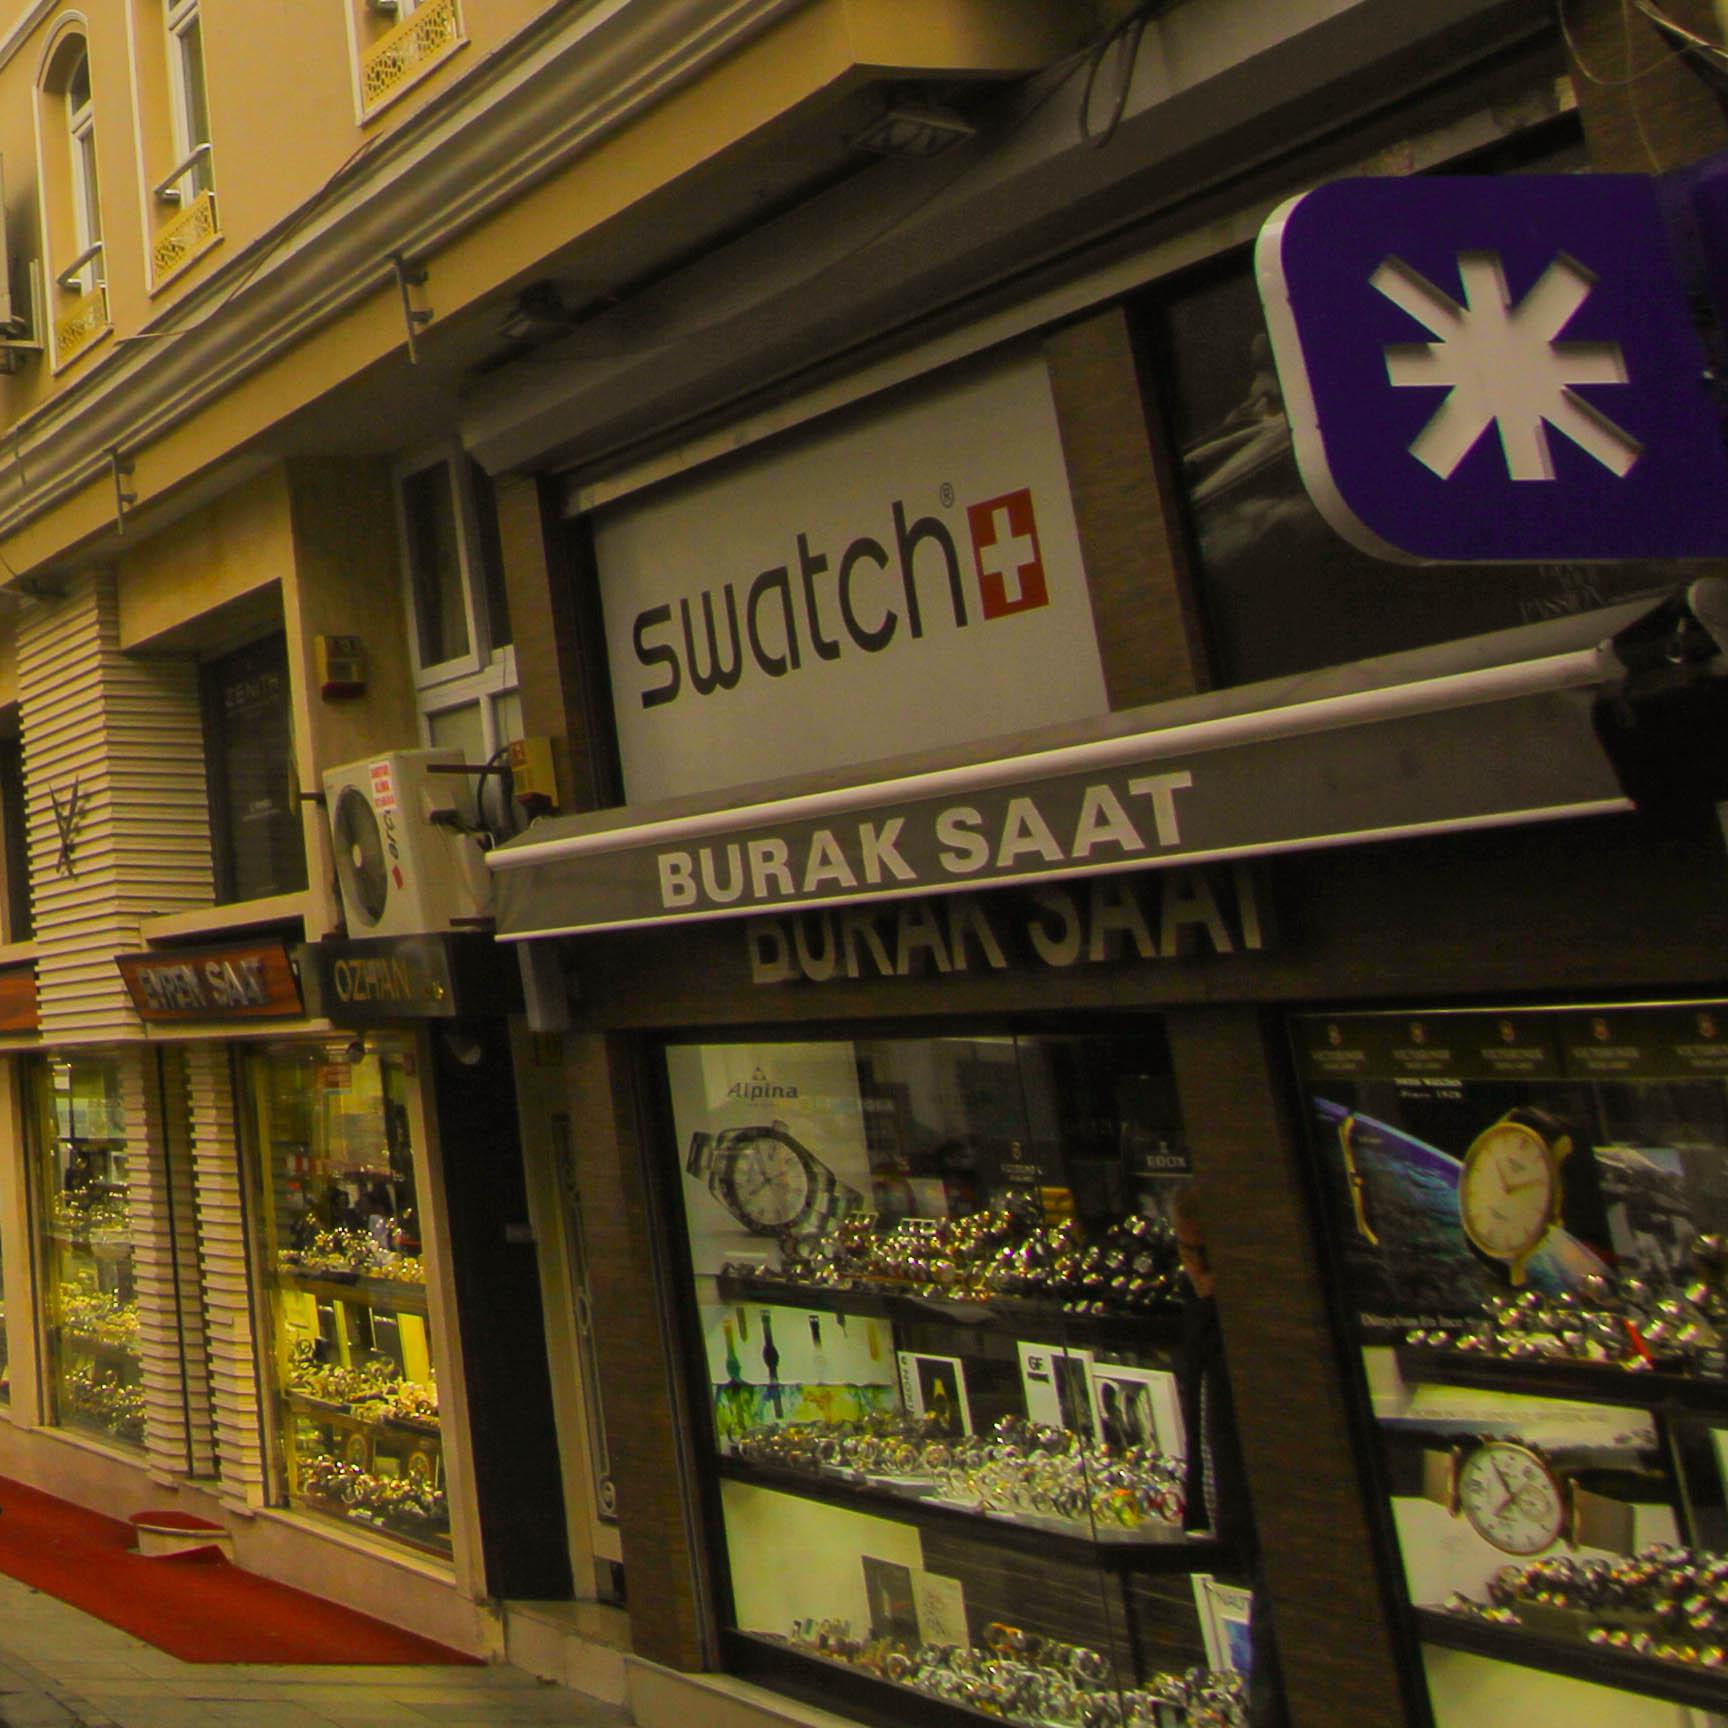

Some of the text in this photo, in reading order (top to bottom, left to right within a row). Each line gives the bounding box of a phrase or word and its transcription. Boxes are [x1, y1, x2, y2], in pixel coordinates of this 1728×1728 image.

[632, 500, 969, 710] swatch
[656, 769, 1194, 910] BURAK SAAT
[727, 1082, 799, 1102] Alpina
